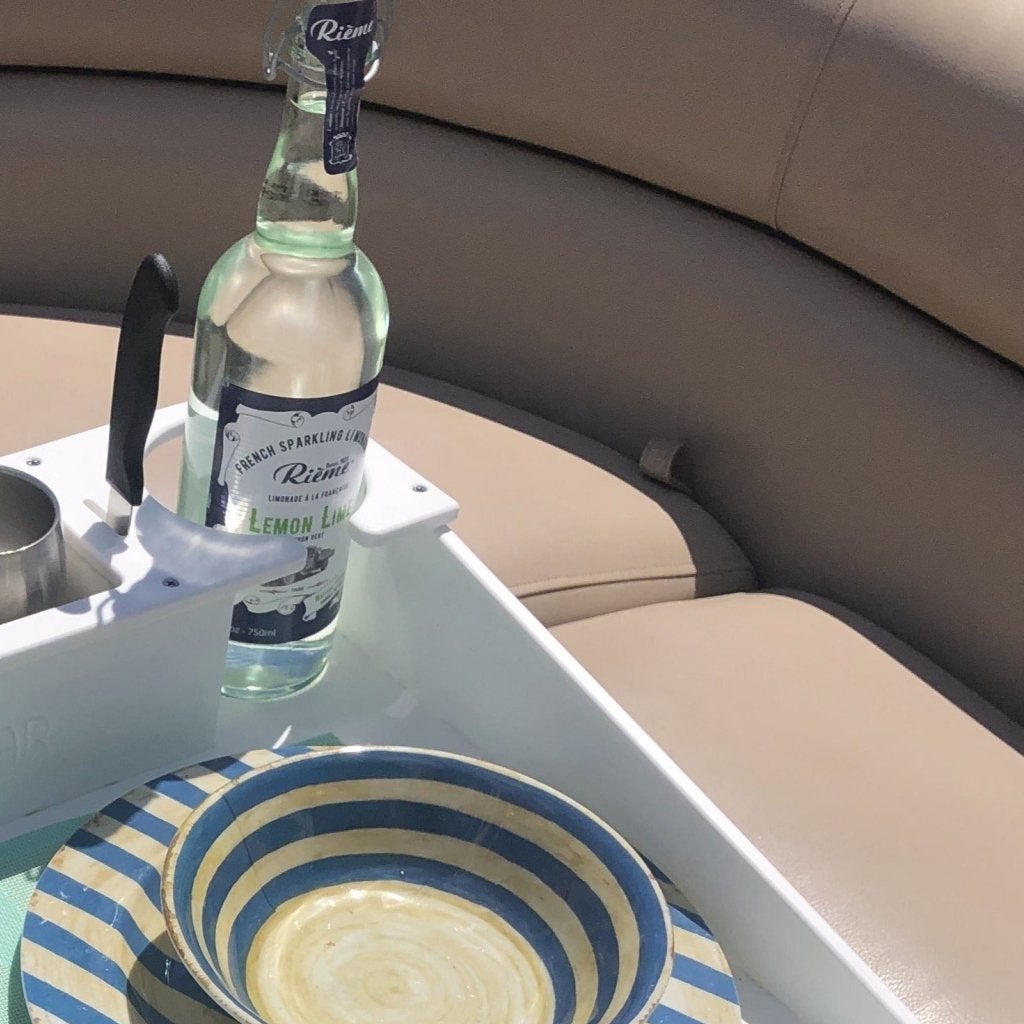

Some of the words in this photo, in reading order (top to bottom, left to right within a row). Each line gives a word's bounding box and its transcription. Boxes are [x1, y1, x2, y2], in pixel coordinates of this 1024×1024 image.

[235, 445, 276, 475] FRENCH
[279, 429, 344, 452] SPARKLING
[273, 462, 350, 485] Rième
[249, 508, 313, 535] LEMON
